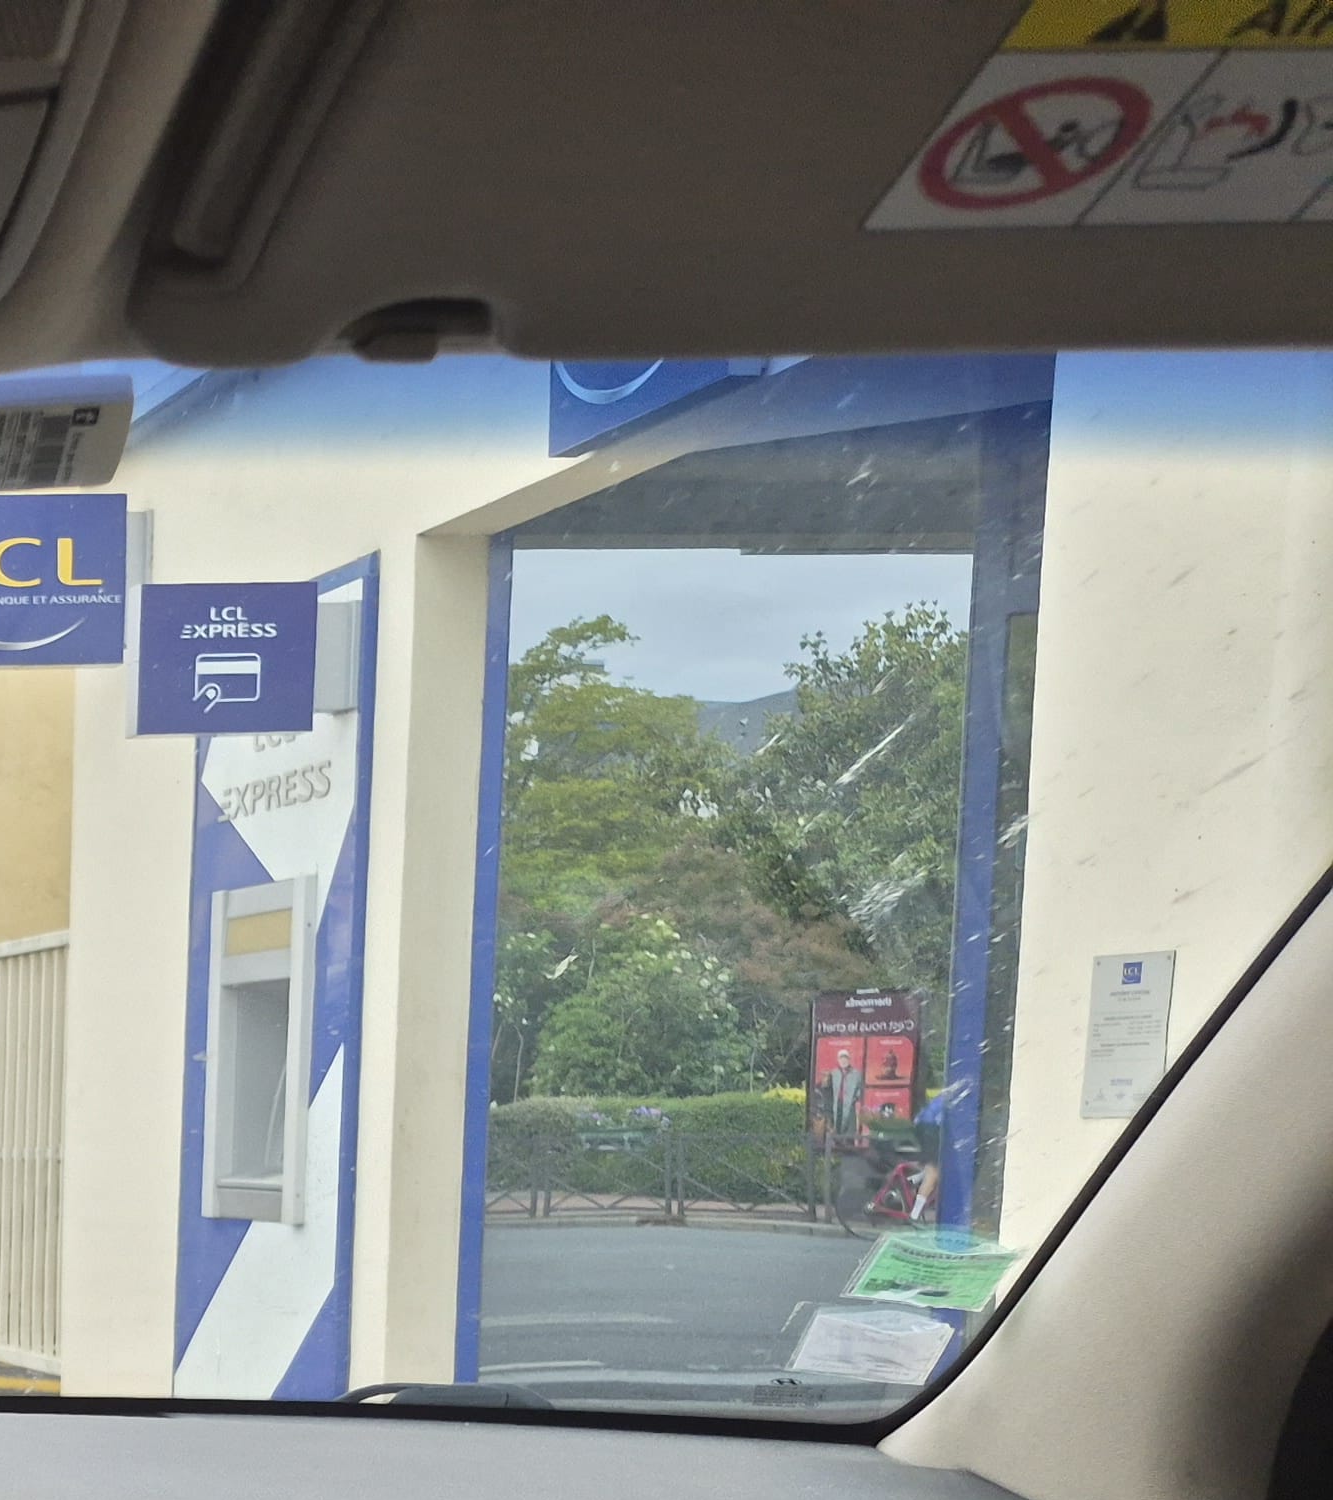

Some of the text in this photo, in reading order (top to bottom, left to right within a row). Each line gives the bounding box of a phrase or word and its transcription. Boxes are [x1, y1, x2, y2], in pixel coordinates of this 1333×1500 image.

[32, 595, 48, 605] ET
[49, 594, 123, 605] ASSURANCE
[209, 606, 248, 621] LCL
[180, 622, 278, 639] EXPRESS
[217, 760, 332, 823] EXPRESS
